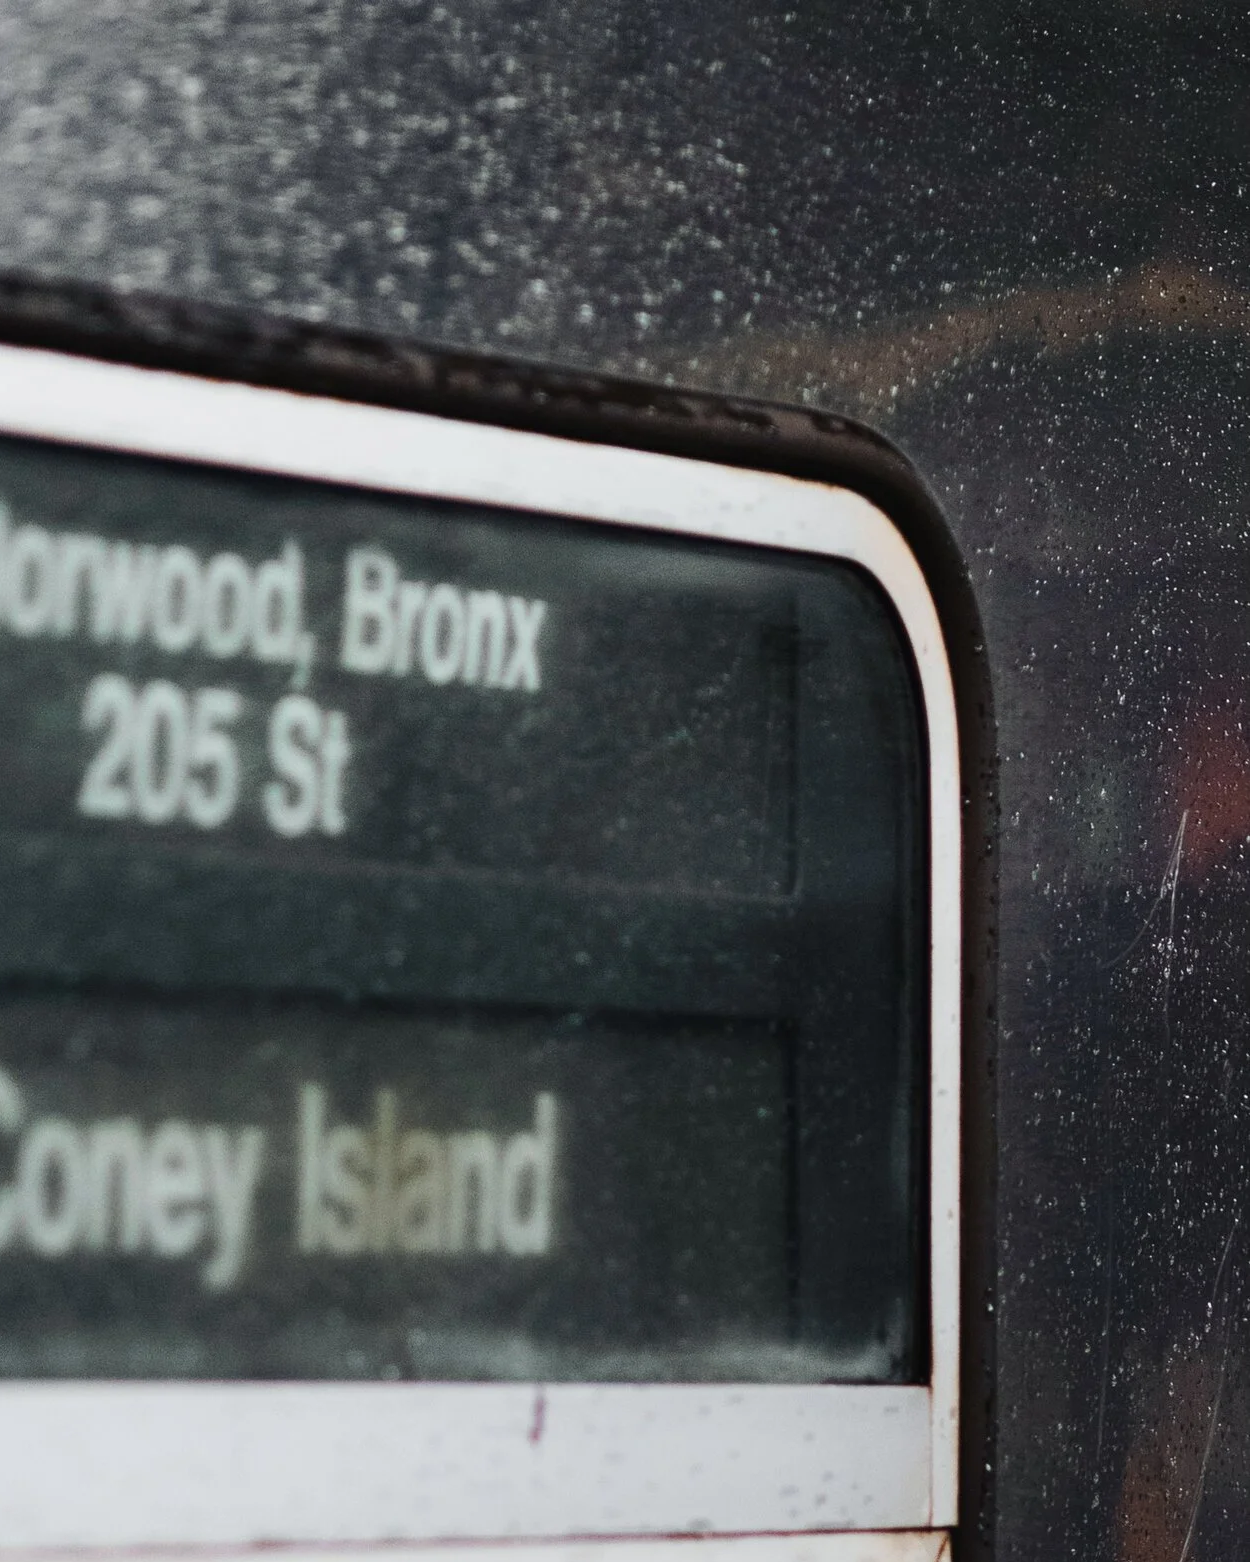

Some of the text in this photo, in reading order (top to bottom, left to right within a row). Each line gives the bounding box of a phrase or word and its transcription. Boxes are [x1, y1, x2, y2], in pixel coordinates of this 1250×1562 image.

[340, 545, 548, 692] Bronx
[77, 673, 352, 837] 205 St
[297, 1082, 559, 1257] Island
